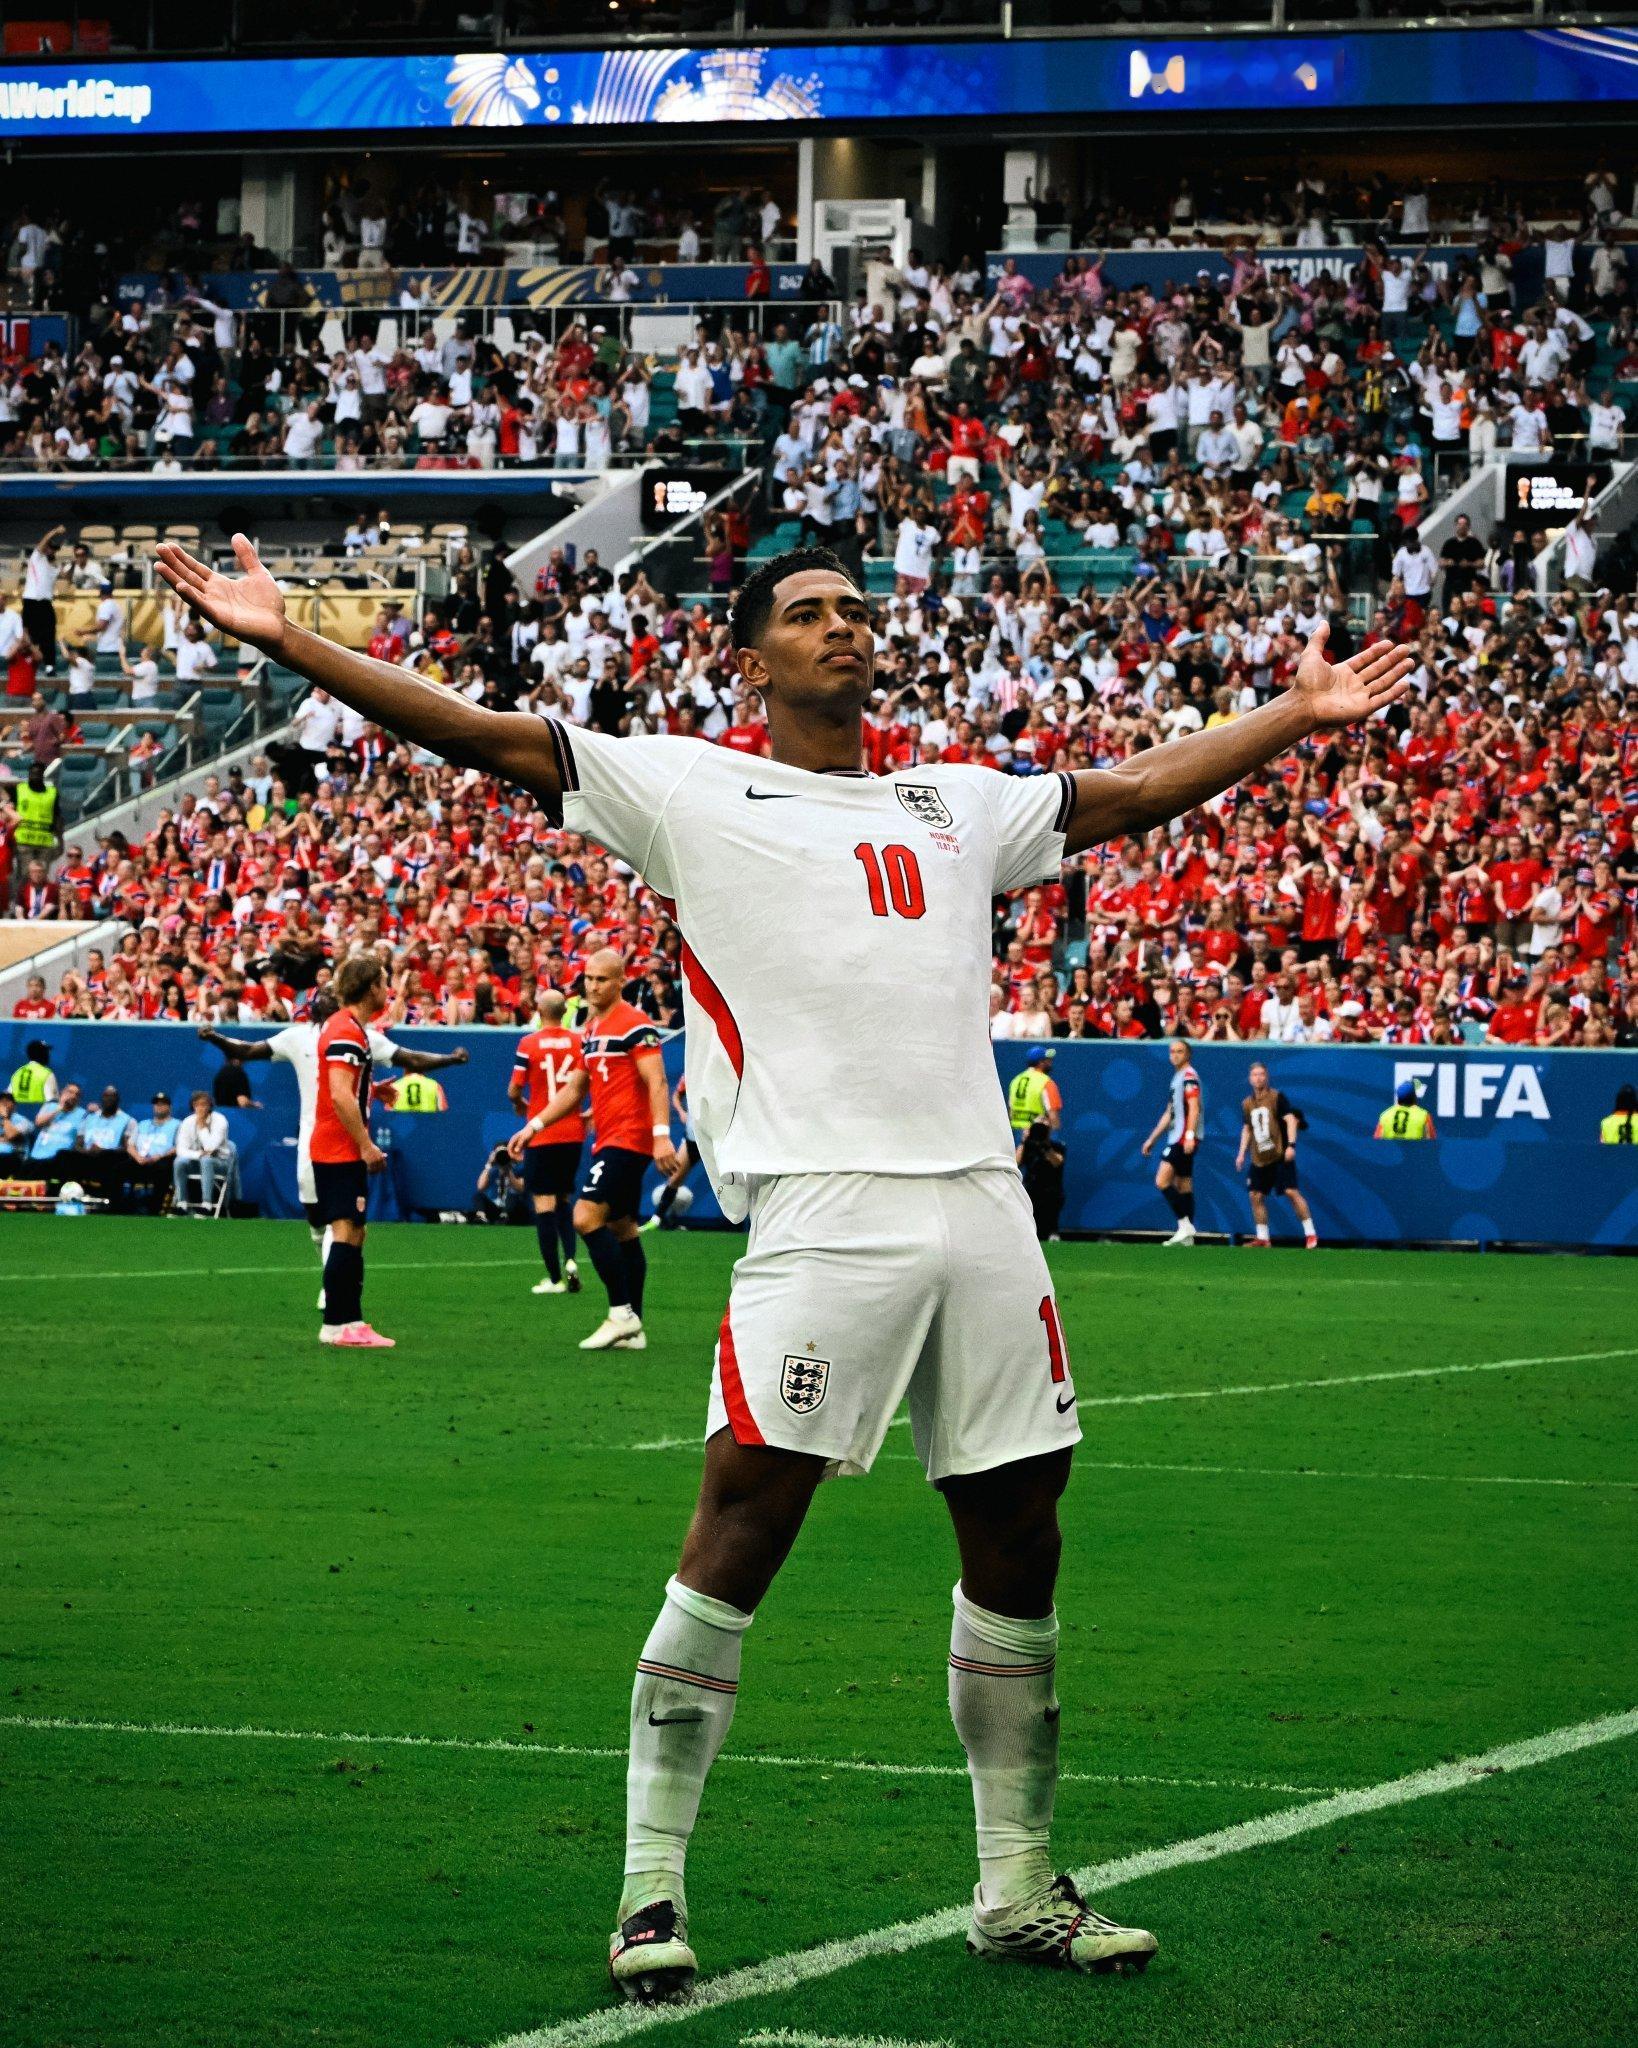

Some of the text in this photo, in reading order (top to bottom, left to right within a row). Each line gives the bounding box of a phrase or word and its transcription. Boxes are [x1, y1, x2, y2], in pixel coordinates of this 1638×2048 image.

[853, 842, 926, 919] 10
[540, 1053, 575, 1104] 14
[597, 1057, 609, 1082] 4
[1394, 1062, 1550, 1120] FIFA
[589, 1160, 605, 1185] 4
[1038, 1294, 1070, 1384] 1
